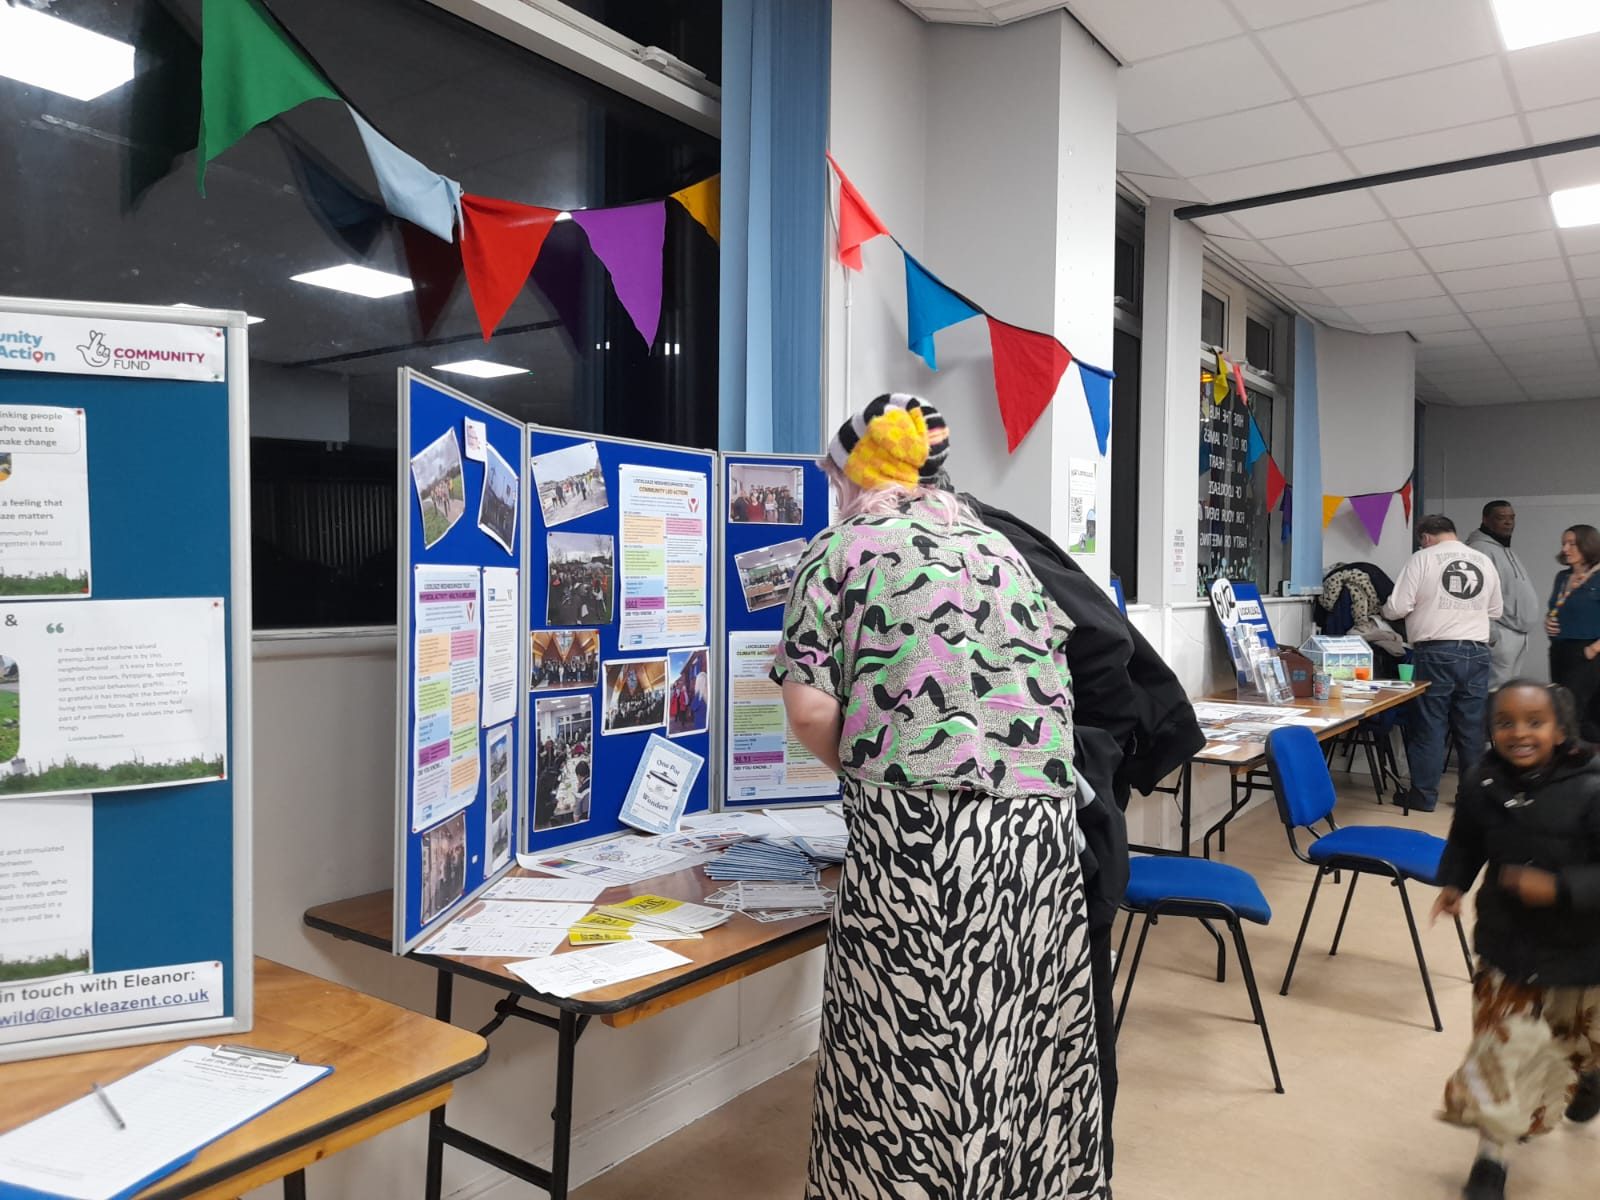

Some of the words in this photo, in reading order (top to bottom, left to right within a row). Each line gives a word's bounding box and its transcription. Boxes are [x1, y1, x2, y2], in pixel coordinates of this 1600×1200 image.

[113, 347, 206, 364] COMMUNITY
[113, 359, 150, 371] FUND
[31, 412, 63, 420] people
[24, 438, 57, 447] change
[10, 499, 41, 508] feeling
[4, 613, 18, 627] &
[656, 759, 670, 769] One
[642, 791, 669, 811] Wonders
[0, 989, 15, 1004] in
[21, 982, 75, 1001] touch
[81, 978, 117, 994] with
[124, 970, 196, 989] Eleanor:
[0, 988, 210, 1026] wild@lockleazent.co.uk
